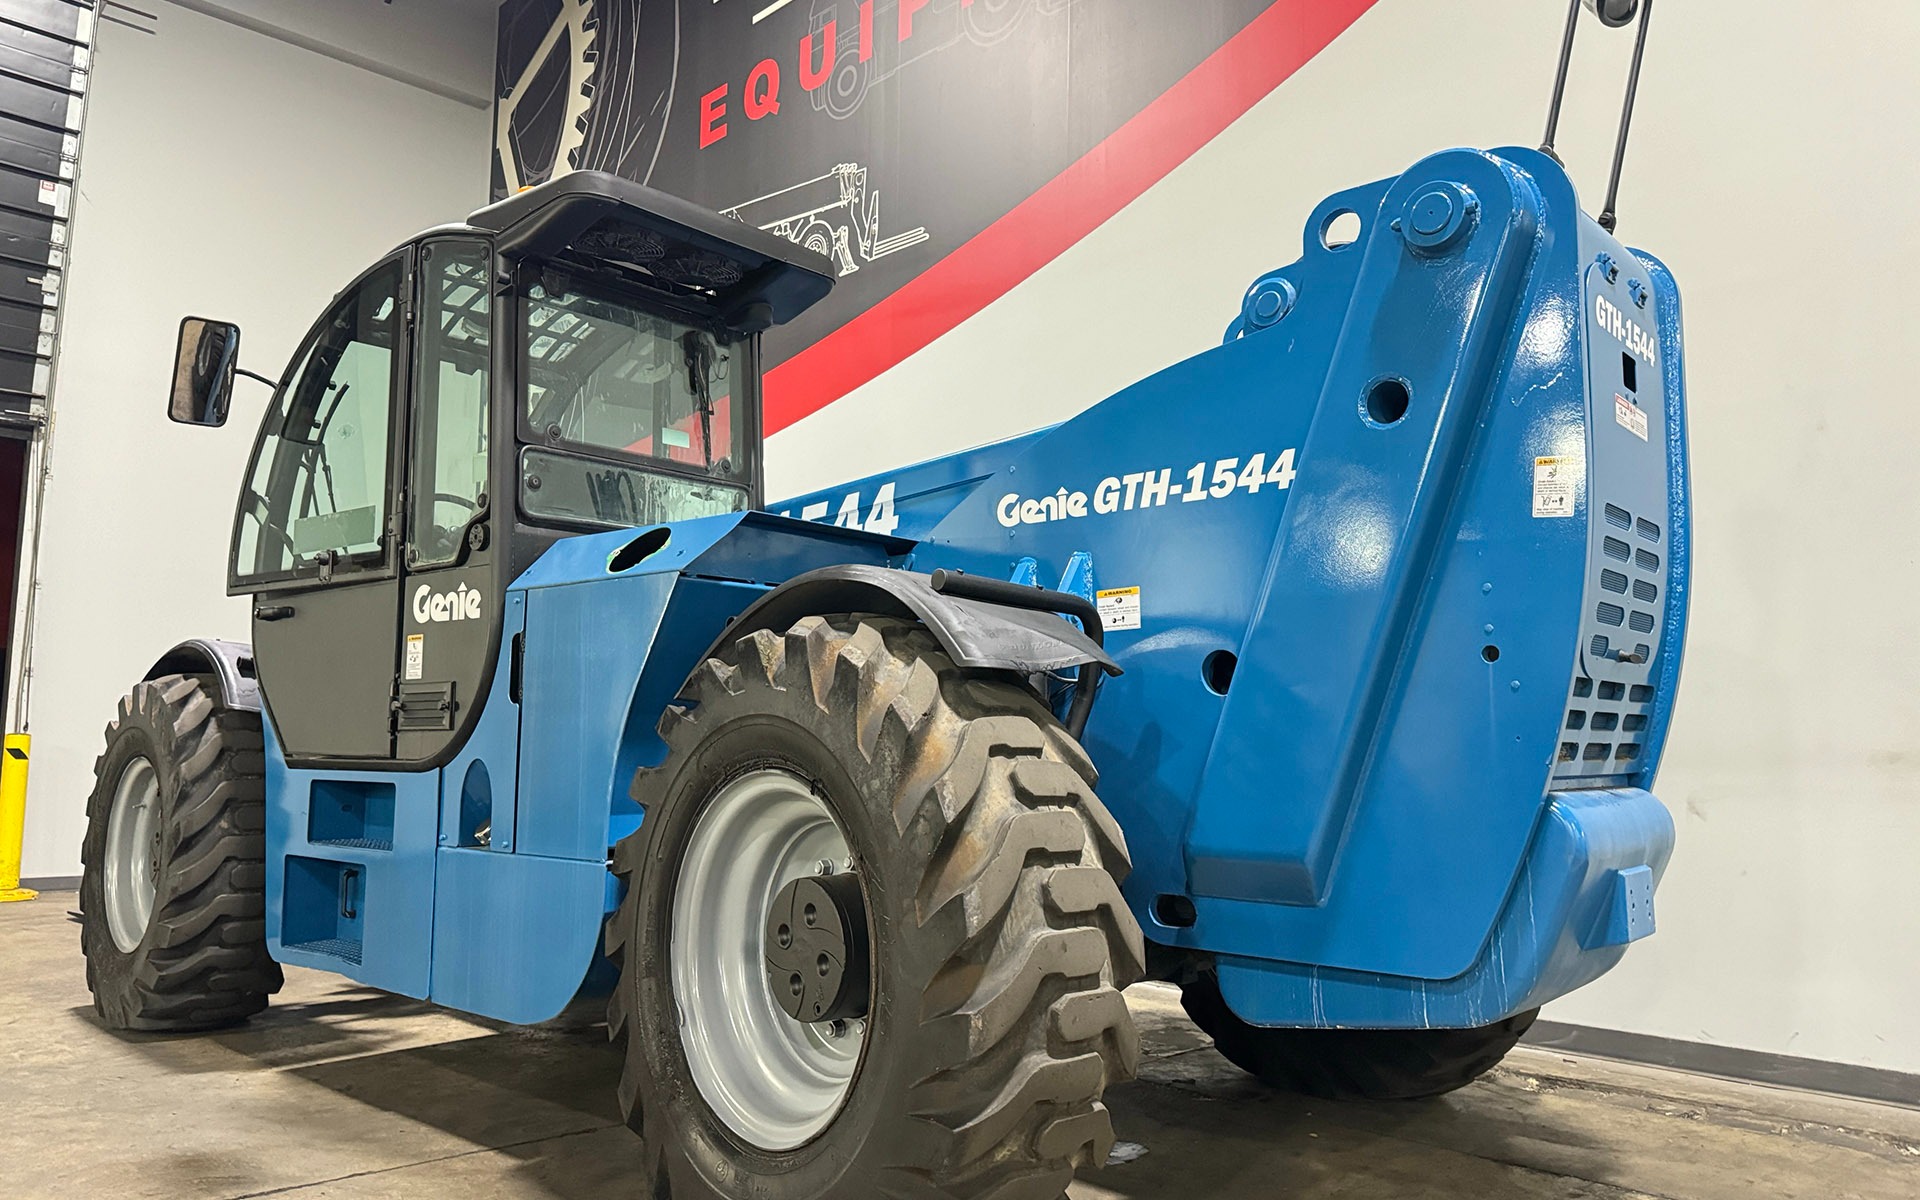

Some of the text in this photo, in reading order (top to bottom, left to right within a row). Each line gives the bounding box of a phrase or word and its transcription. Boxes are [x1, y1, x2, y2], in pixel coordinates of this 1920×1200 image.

[700, 0, 973, 149] EQUIP
[1595, 294, 1656, 367] GTH-1544
[996, 448, 1297, 528] Genie GTH-1544
[413, 581, 482, 624] Genie
